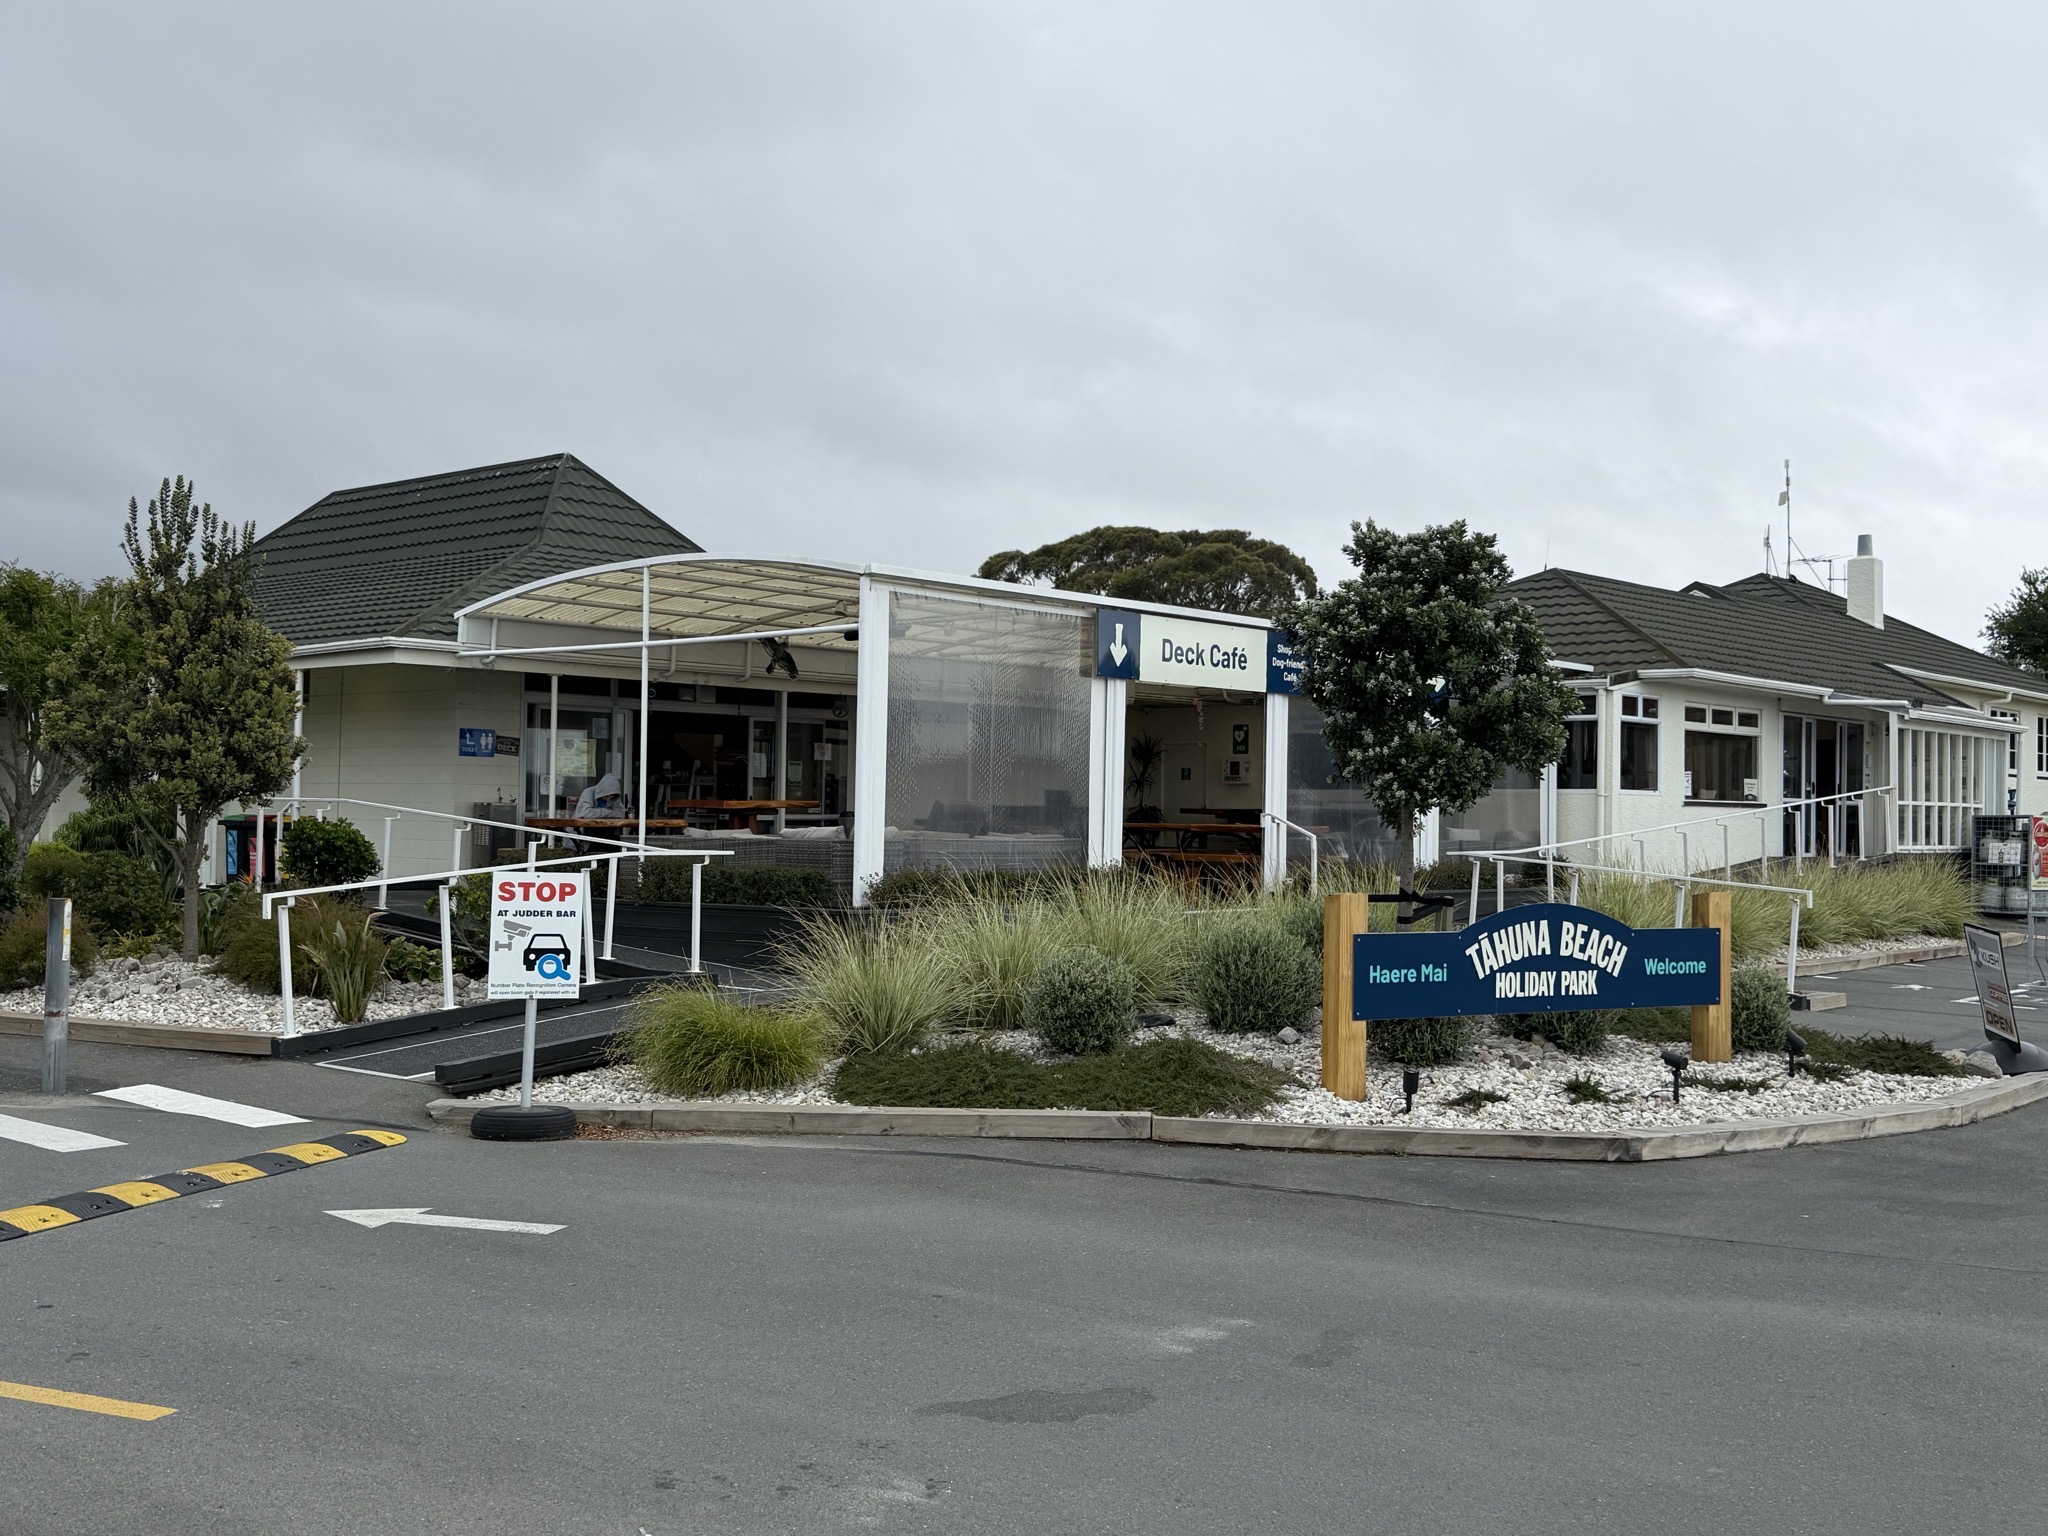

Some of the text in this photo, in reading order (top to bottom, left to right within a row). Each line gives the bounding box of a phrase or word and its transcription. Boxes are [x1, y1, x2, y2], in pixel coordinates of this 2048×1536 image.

[1161, 638, 1248, 671] Deck Café
[497, 744, 517, 753] DECK
[497, 881, 577, 903] STOP
[497, 909, 577, 918] AT JUDDER BAR
[1465, 919, 1628, 980] TĀHUNA BEACH
[1980, 950, 2000, 967] KUSH
[1369, 962, 1448, 984] Haere Mai
[1644, 957, 1707, 976] Welcome
[1495, 969, 1598, 999] HOLIDAY PARK
[1988, 987, 2010, 1004] COFFEE
[1985, 1010, 2014, 1035] OPEN
